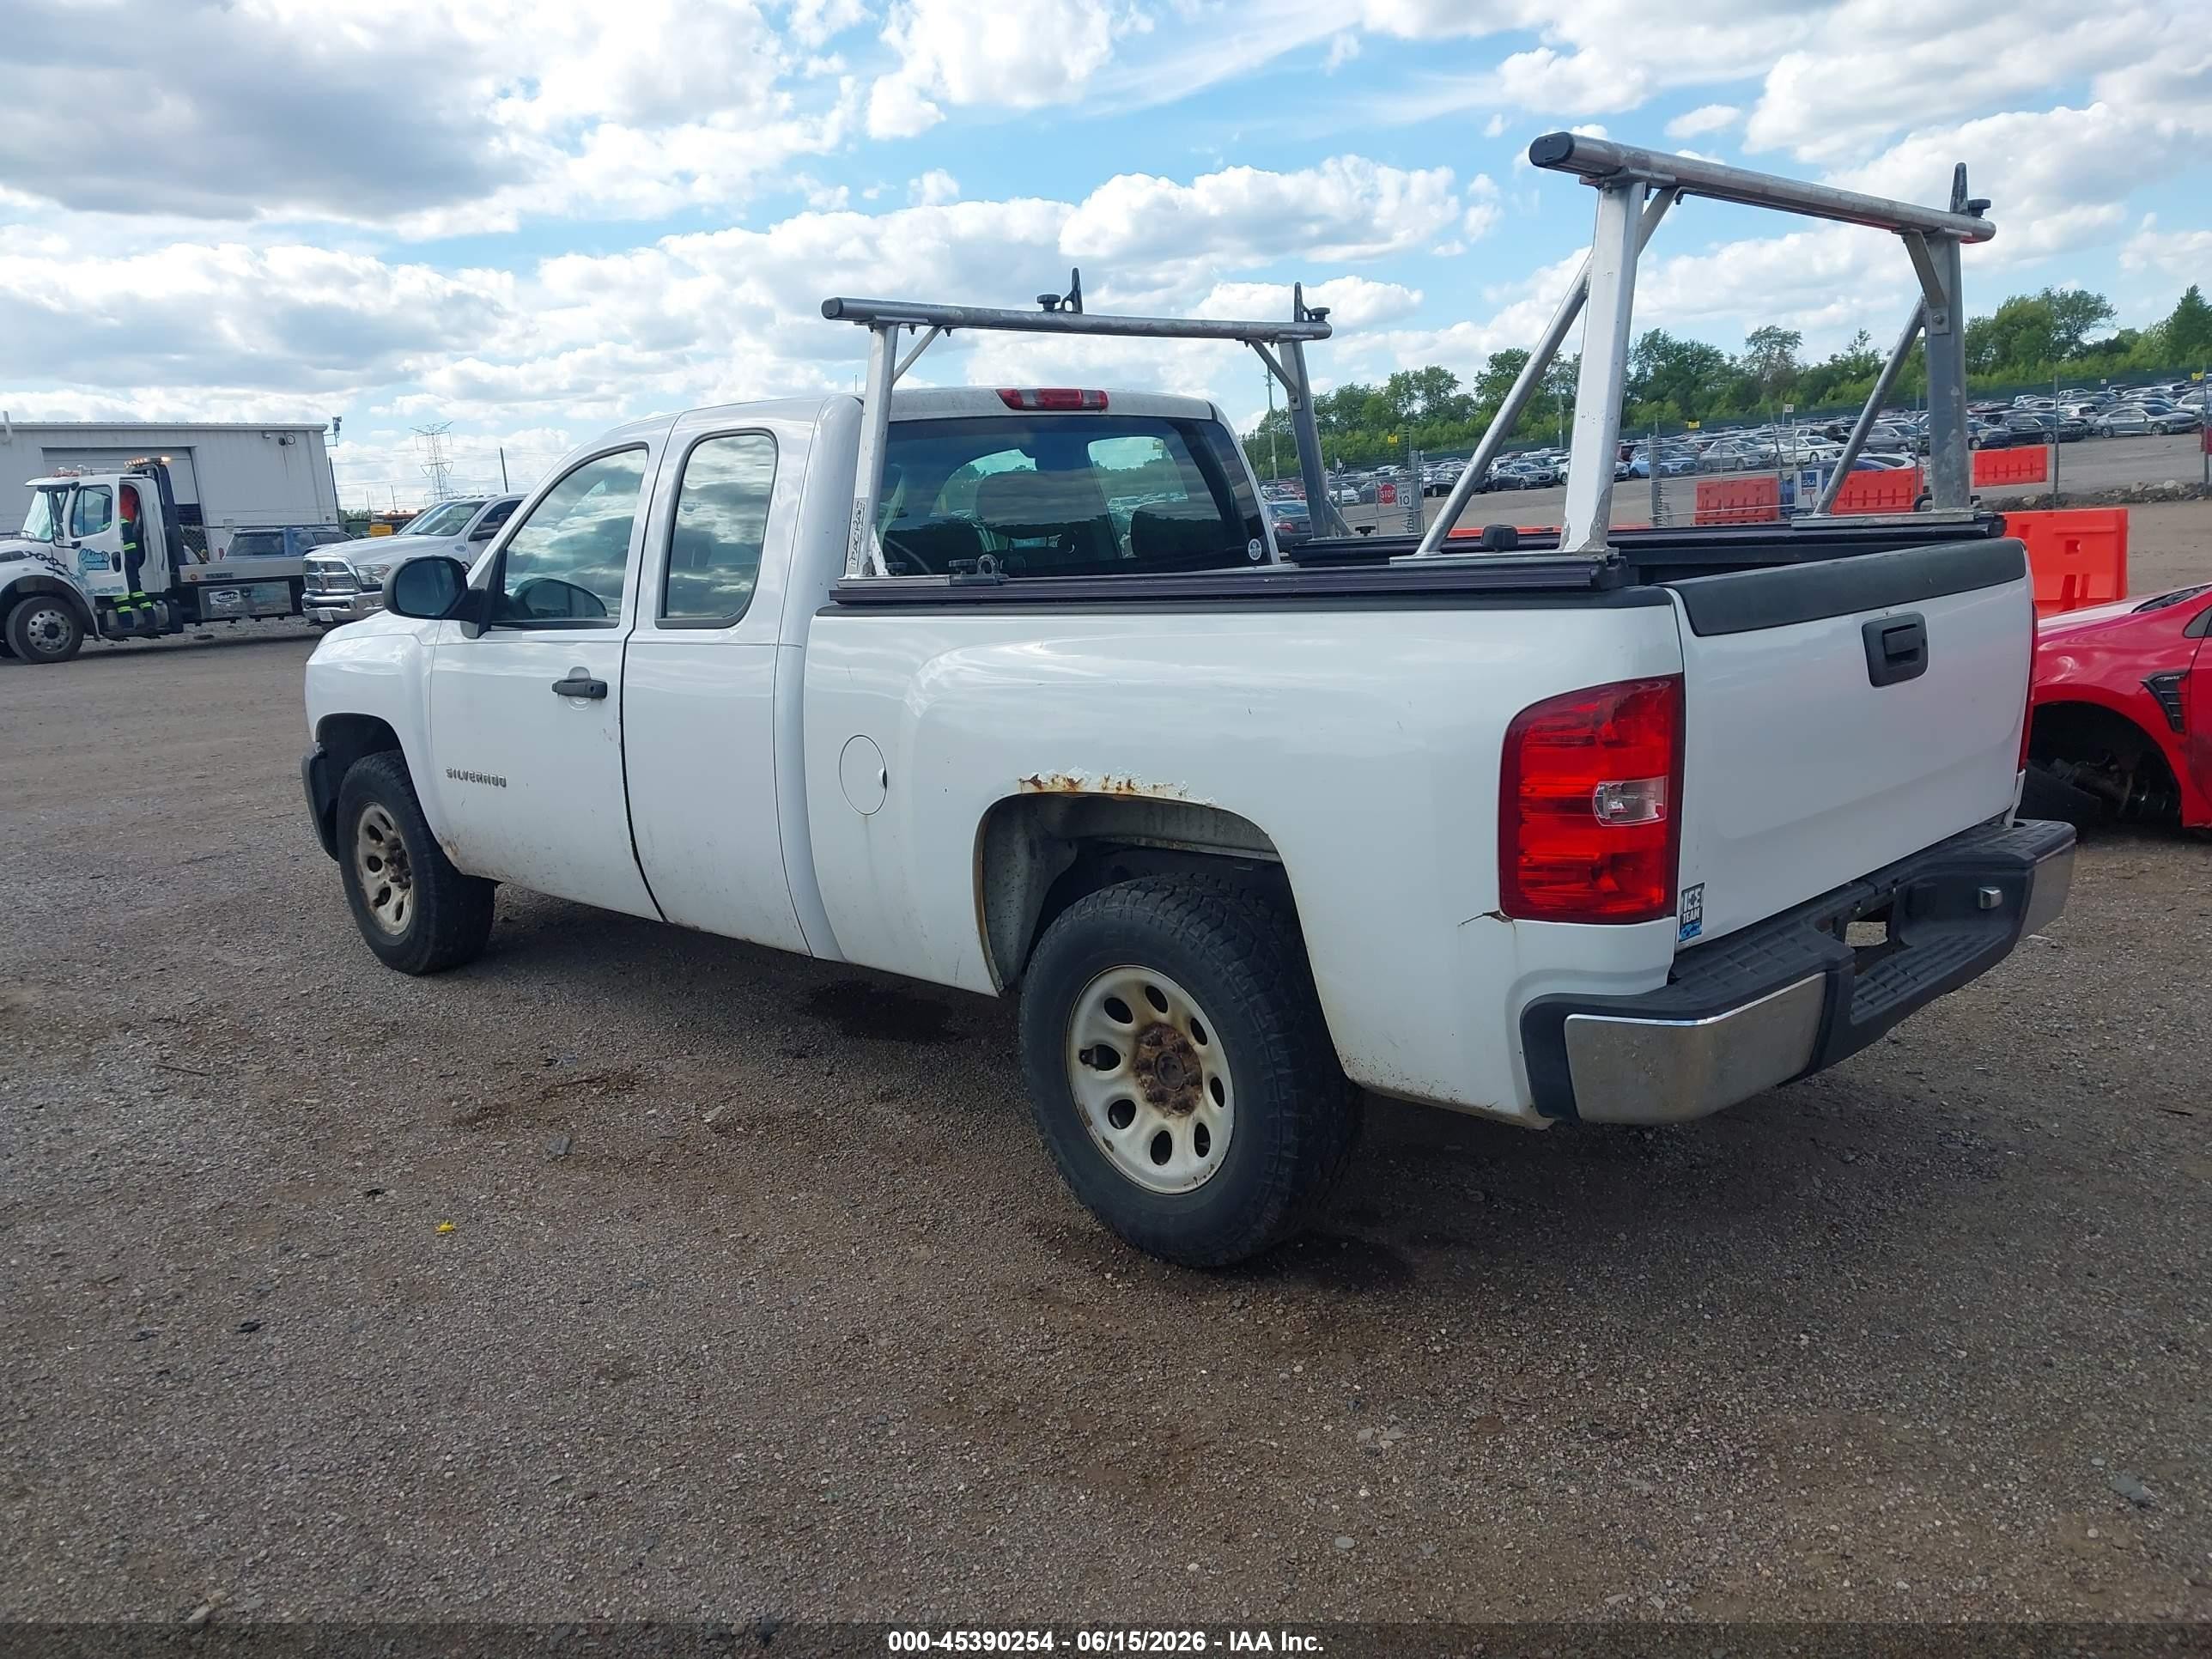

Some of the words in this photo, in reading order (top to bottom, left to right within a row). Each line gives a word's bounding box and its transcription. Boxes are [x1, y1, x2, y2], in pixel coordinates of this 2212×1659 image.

[1380, 489, 1395, 499] STOP
[1400, 495, 1410, 505] 10
[446, 767, 507, 788] SILVERADO
[1683, 887, 1701, 912] ICE
[1682, 908, 1700, 924] TEAM
